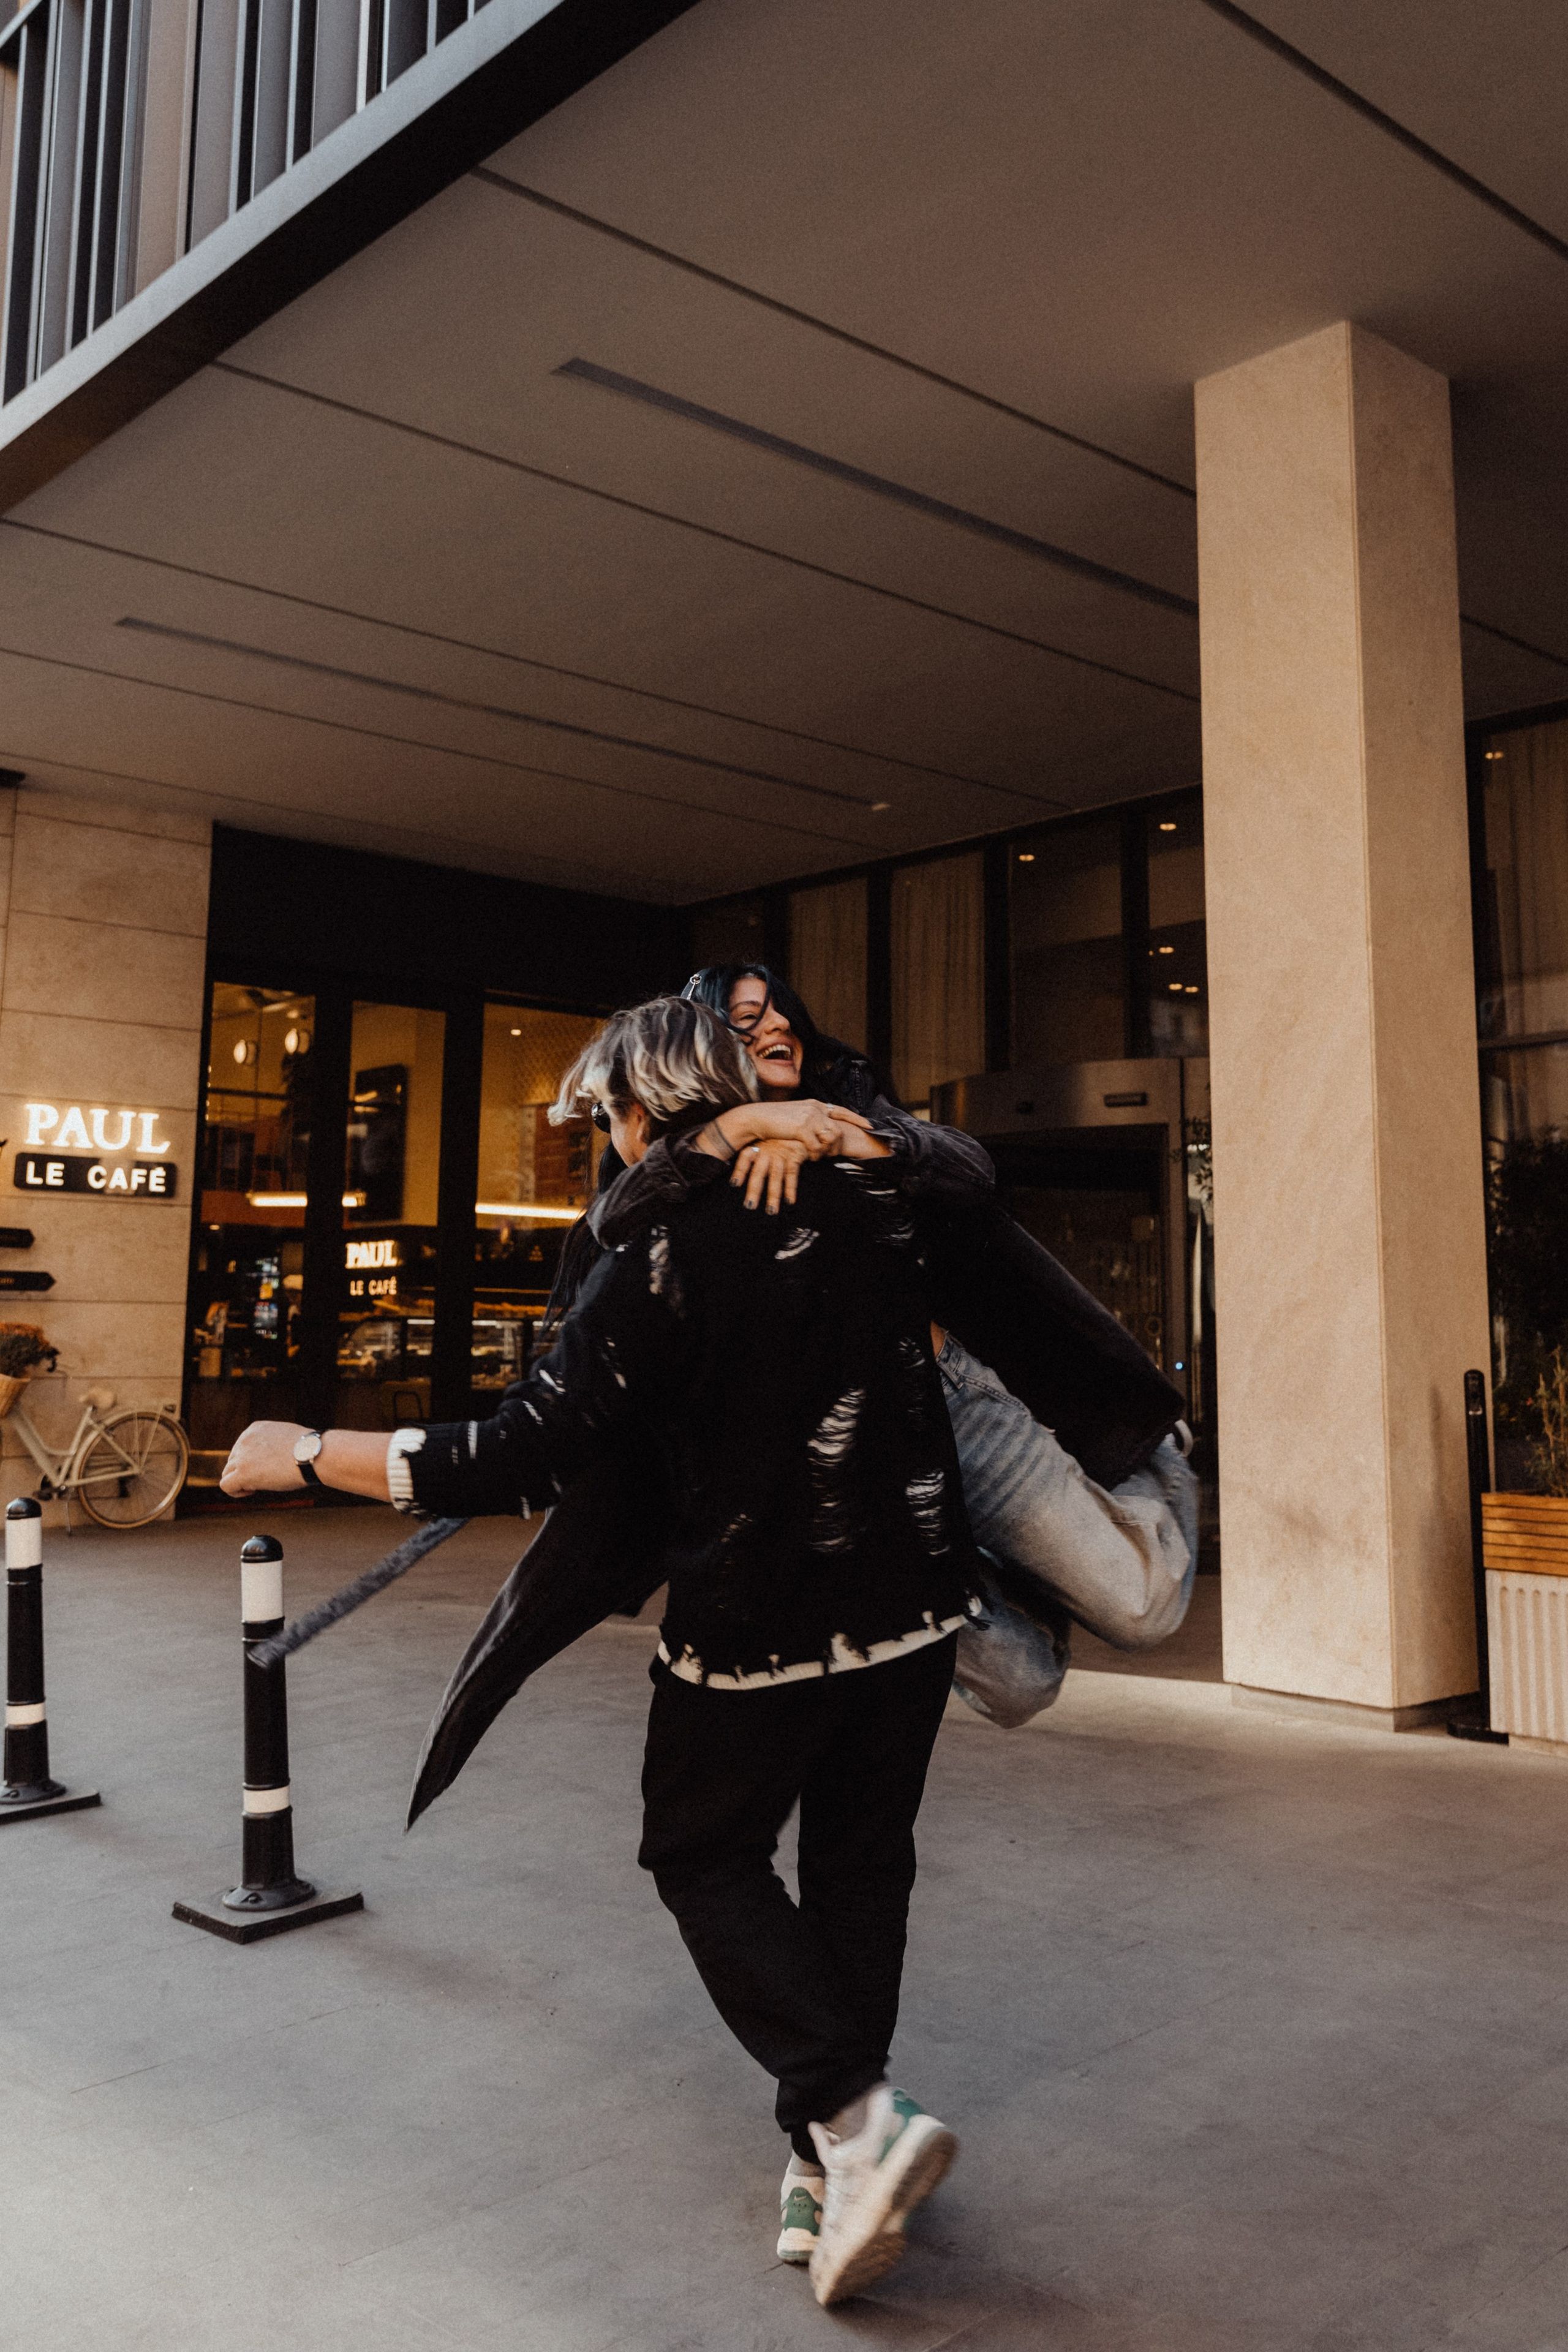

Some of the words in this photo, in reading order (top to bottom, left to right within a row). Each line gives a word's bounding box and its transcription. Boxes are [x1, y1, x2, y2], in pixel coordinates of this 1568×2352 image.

[24, 1103, 171, 1154] PAUL
[26, 1161, 64, 1186] LE
[88, 1165, 166, 1193] CAFÉ
[345, 1240, 398, 1268] PAUL
[350, 1280, 364, 1296] LE
[368, 1276, 397, 1295] CAFÉ
